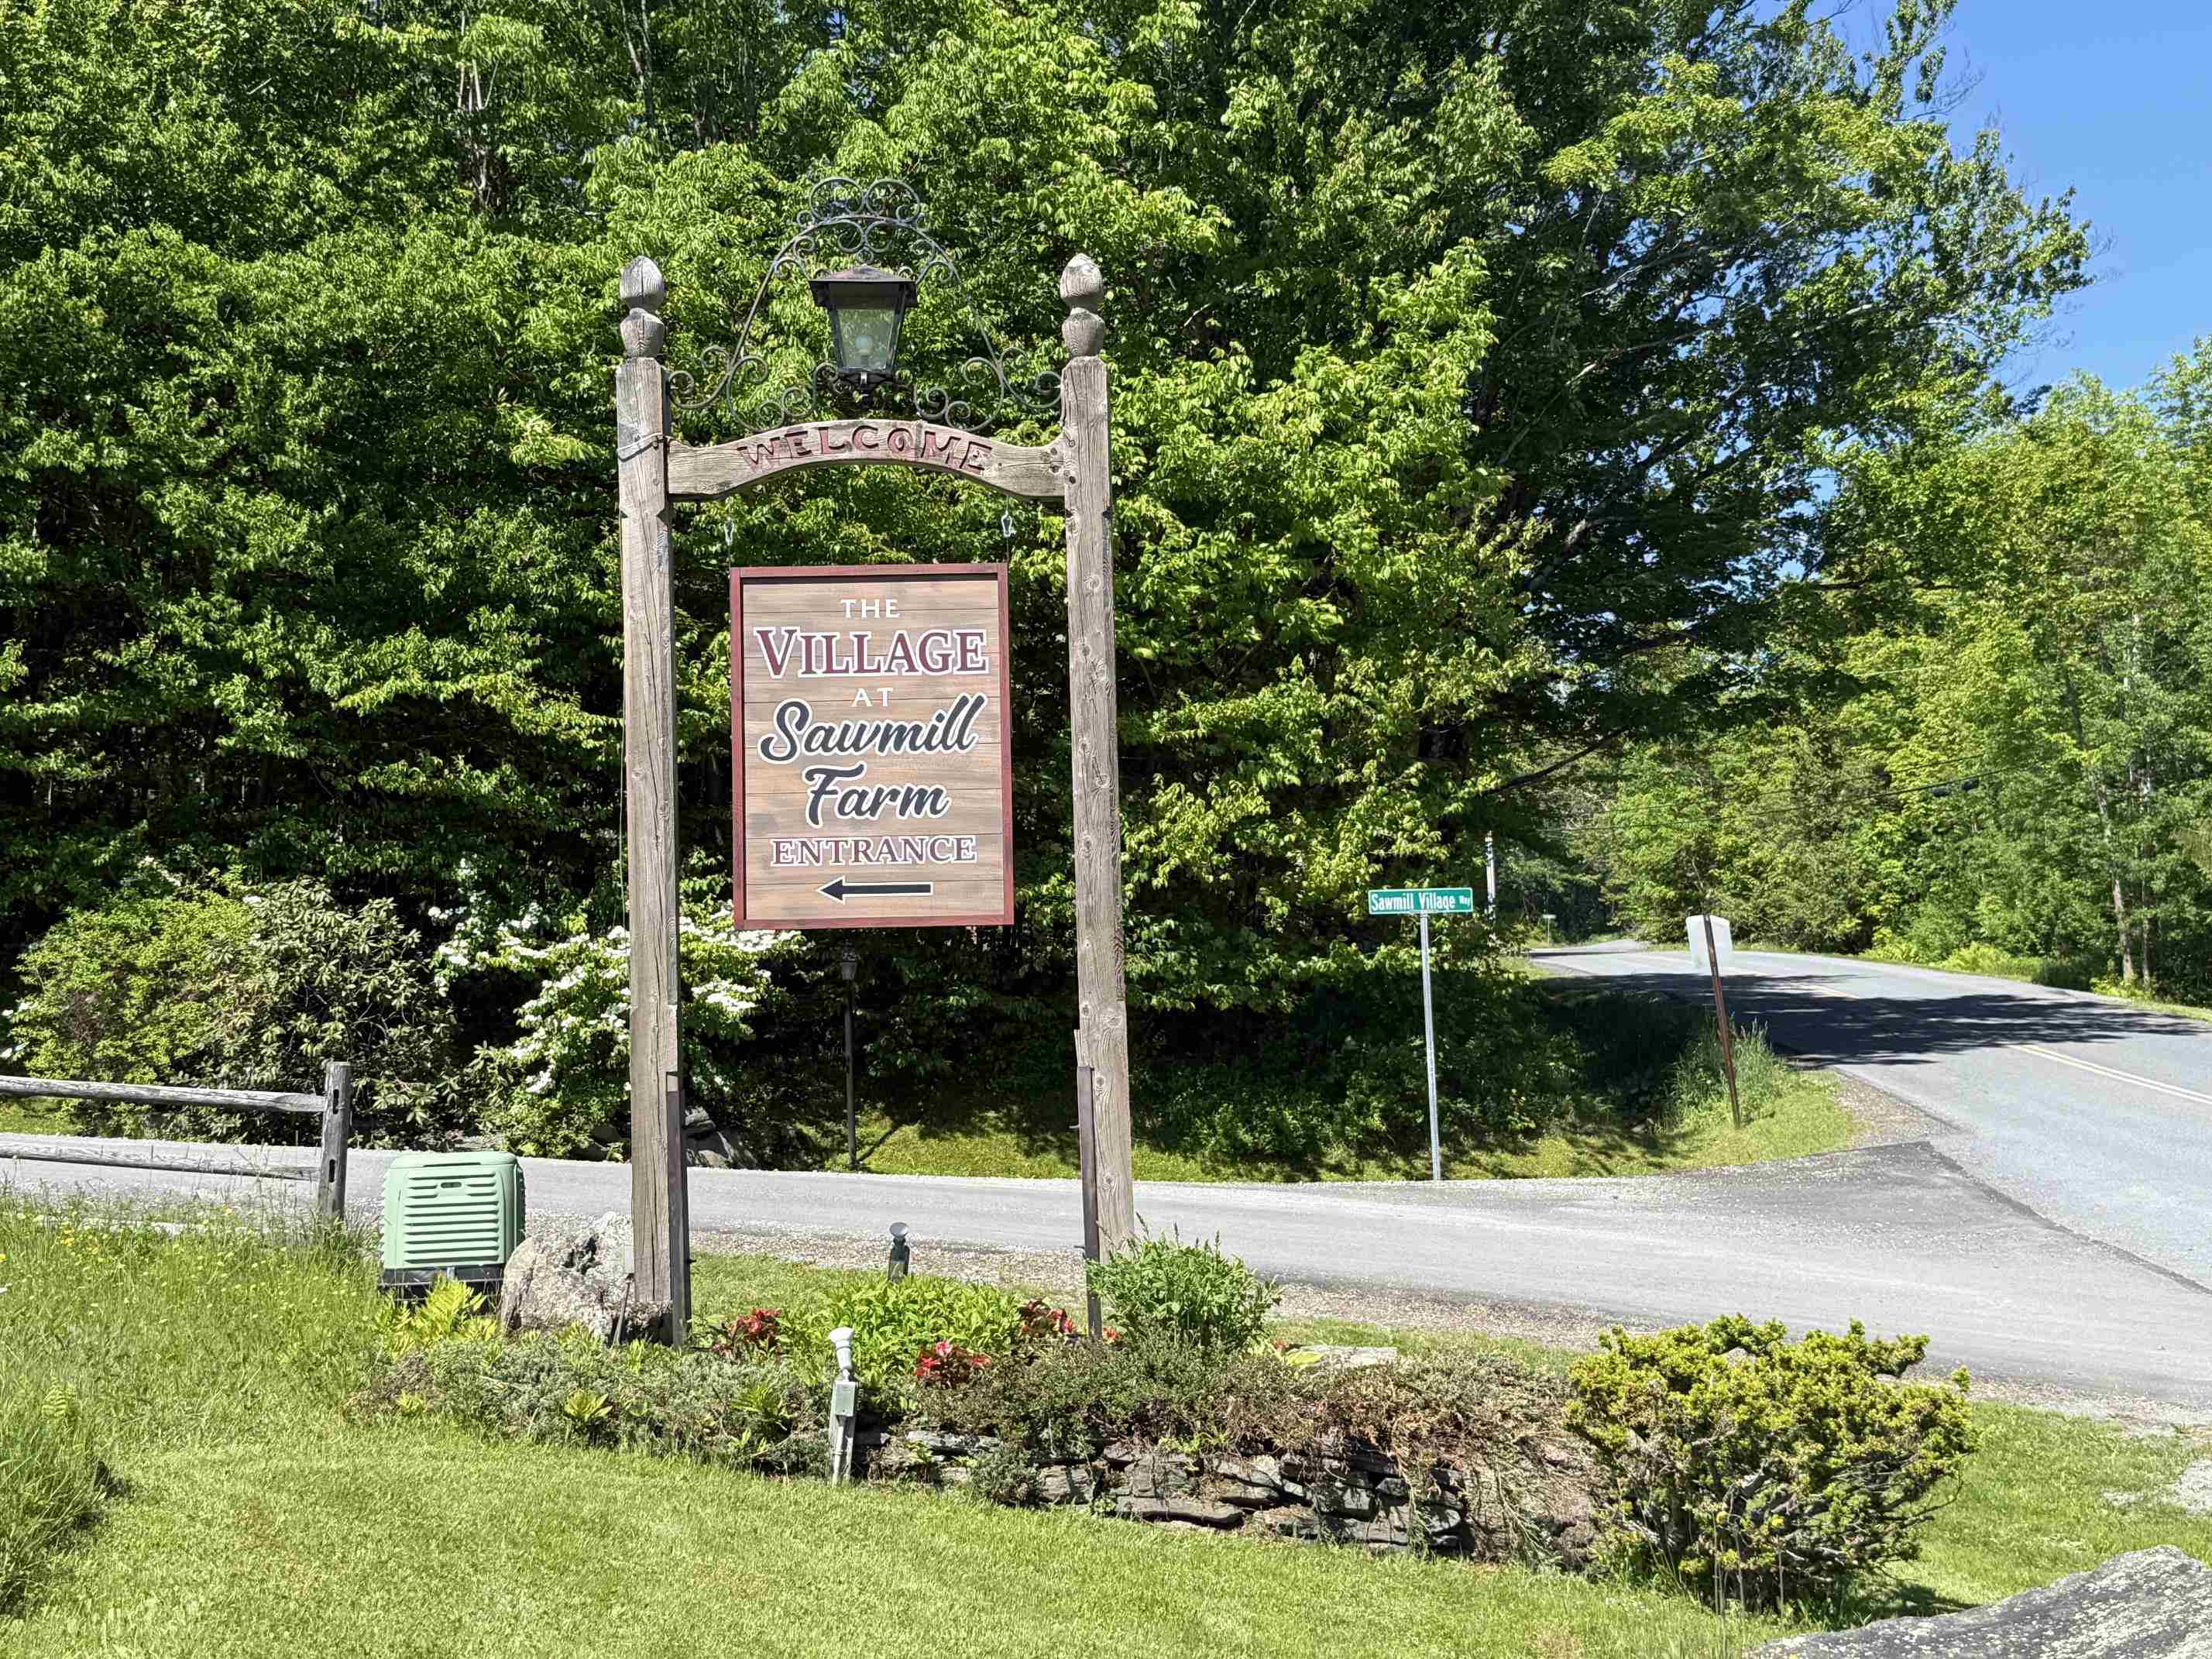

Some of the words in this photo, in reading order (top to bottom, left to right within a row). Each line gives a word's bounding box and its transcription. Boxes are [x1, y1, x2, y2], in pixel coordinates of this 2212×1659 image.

[737, 425, 992, 472] WELCOME
[840, 598, 900, 619] THE
[754, 627, 989, 678] VILLAGE
[853, 687, 893, 707] AT
[758, 693, 988, 762] Sawmill
[803, 761, 952, 828] Farm
[771, 835, 977, 867] ENTRANCE
[1372, 892, 1414, 911] Sawmill
[1418, 891, 1455, 910] Village
